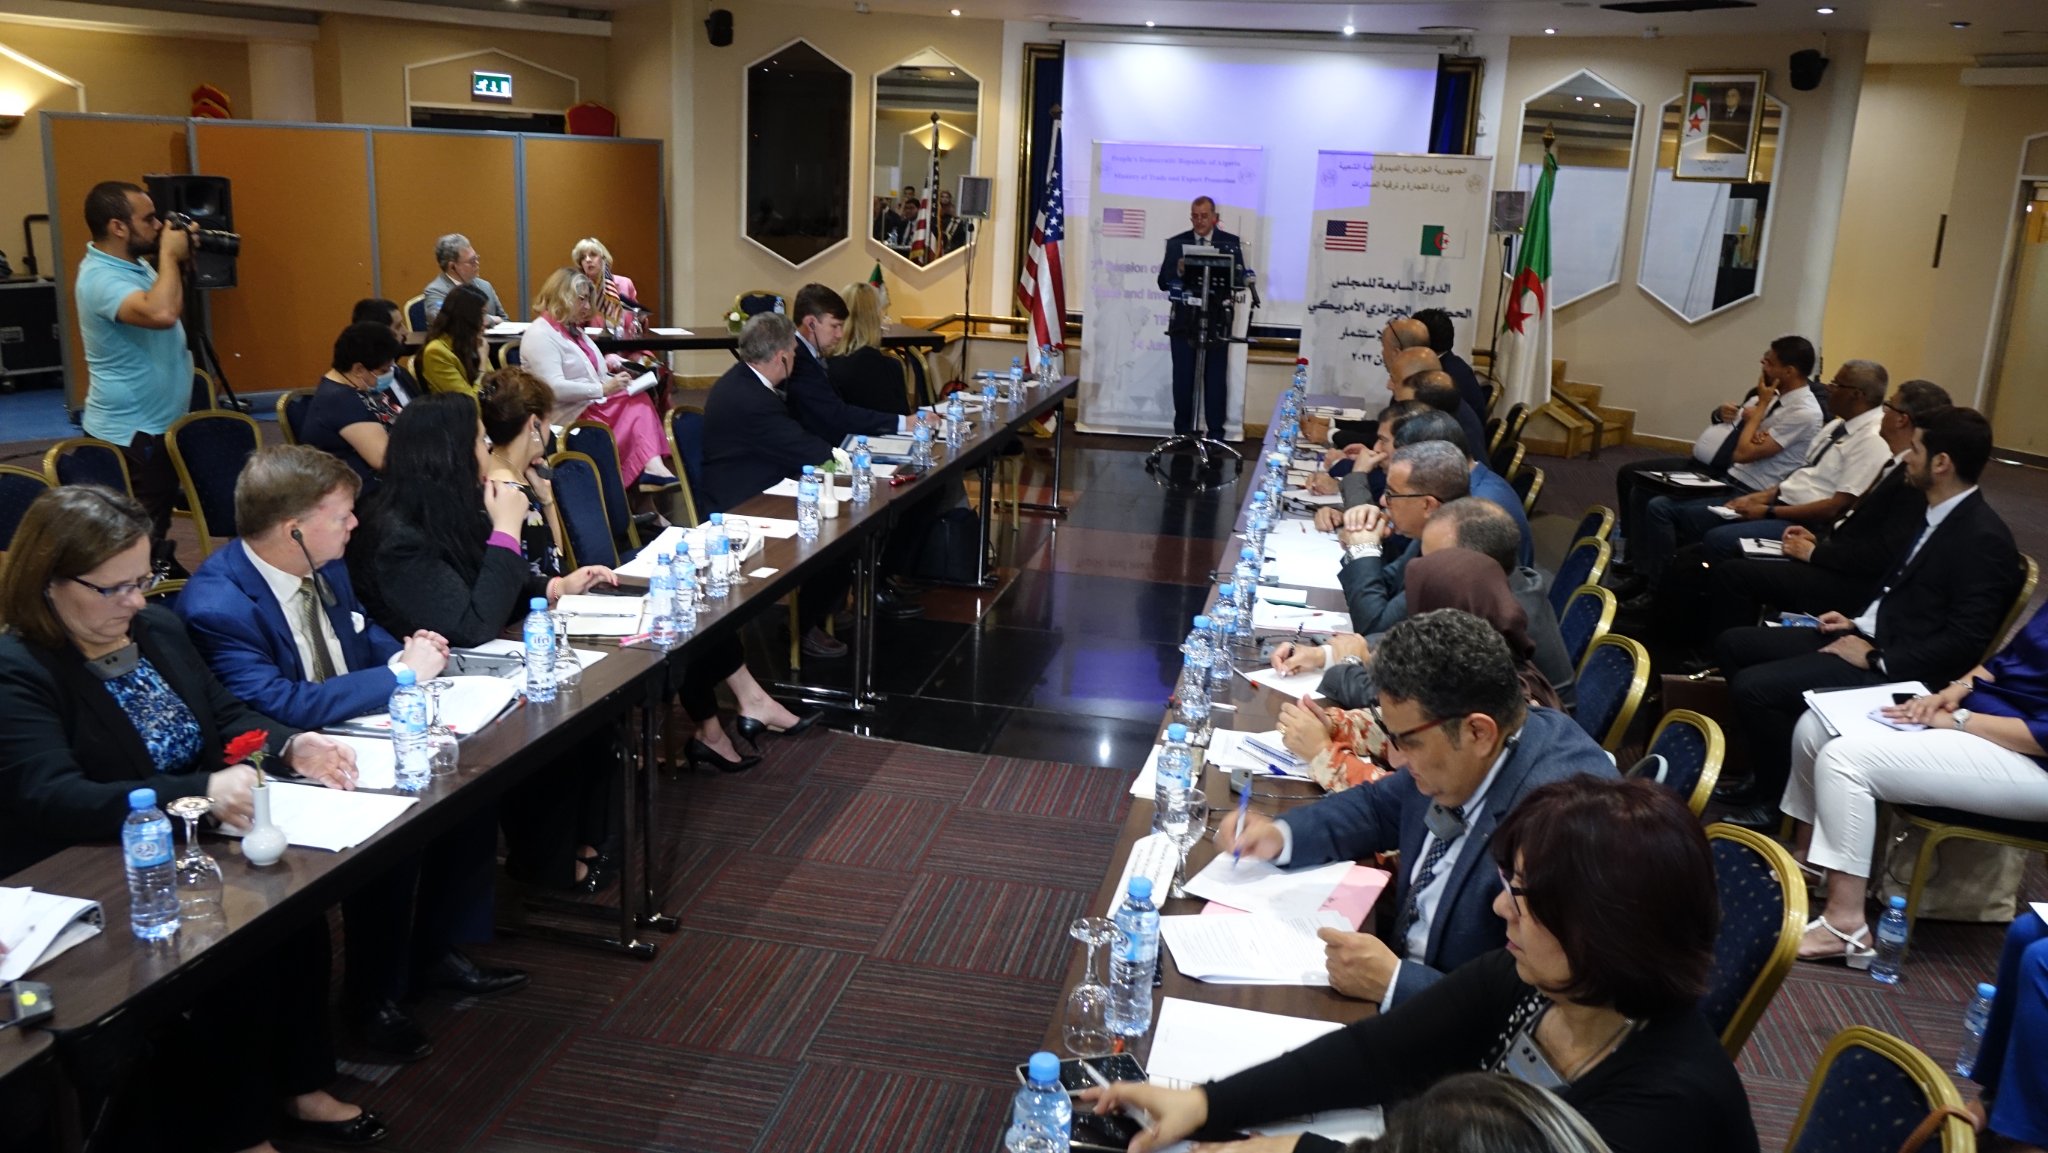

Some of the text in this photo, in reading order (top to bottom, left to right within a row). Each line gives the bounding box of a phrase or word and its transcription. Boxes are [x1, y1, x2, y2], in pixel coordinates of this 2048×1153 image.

[1139, 156, 1176, 165] Democratic
[1178, 157, 1207, 167] Republic
[1218, 159, 1241, 168] Algeria
[1113, 172, 1140, 182] Ministry
[1149, 174, 1167, 182] Trade
[1181, 175, 1202, 185] Export
[1204, 176, 1236, 185] Promotion
[1331, 276, 1450, 296] الدورة السابعة للمجلس
[1123, 288, 1144, 299] and
[1307, 298, 1365, 315] الأمريكي
[1365, 303, 1412, 318] الجزائري
